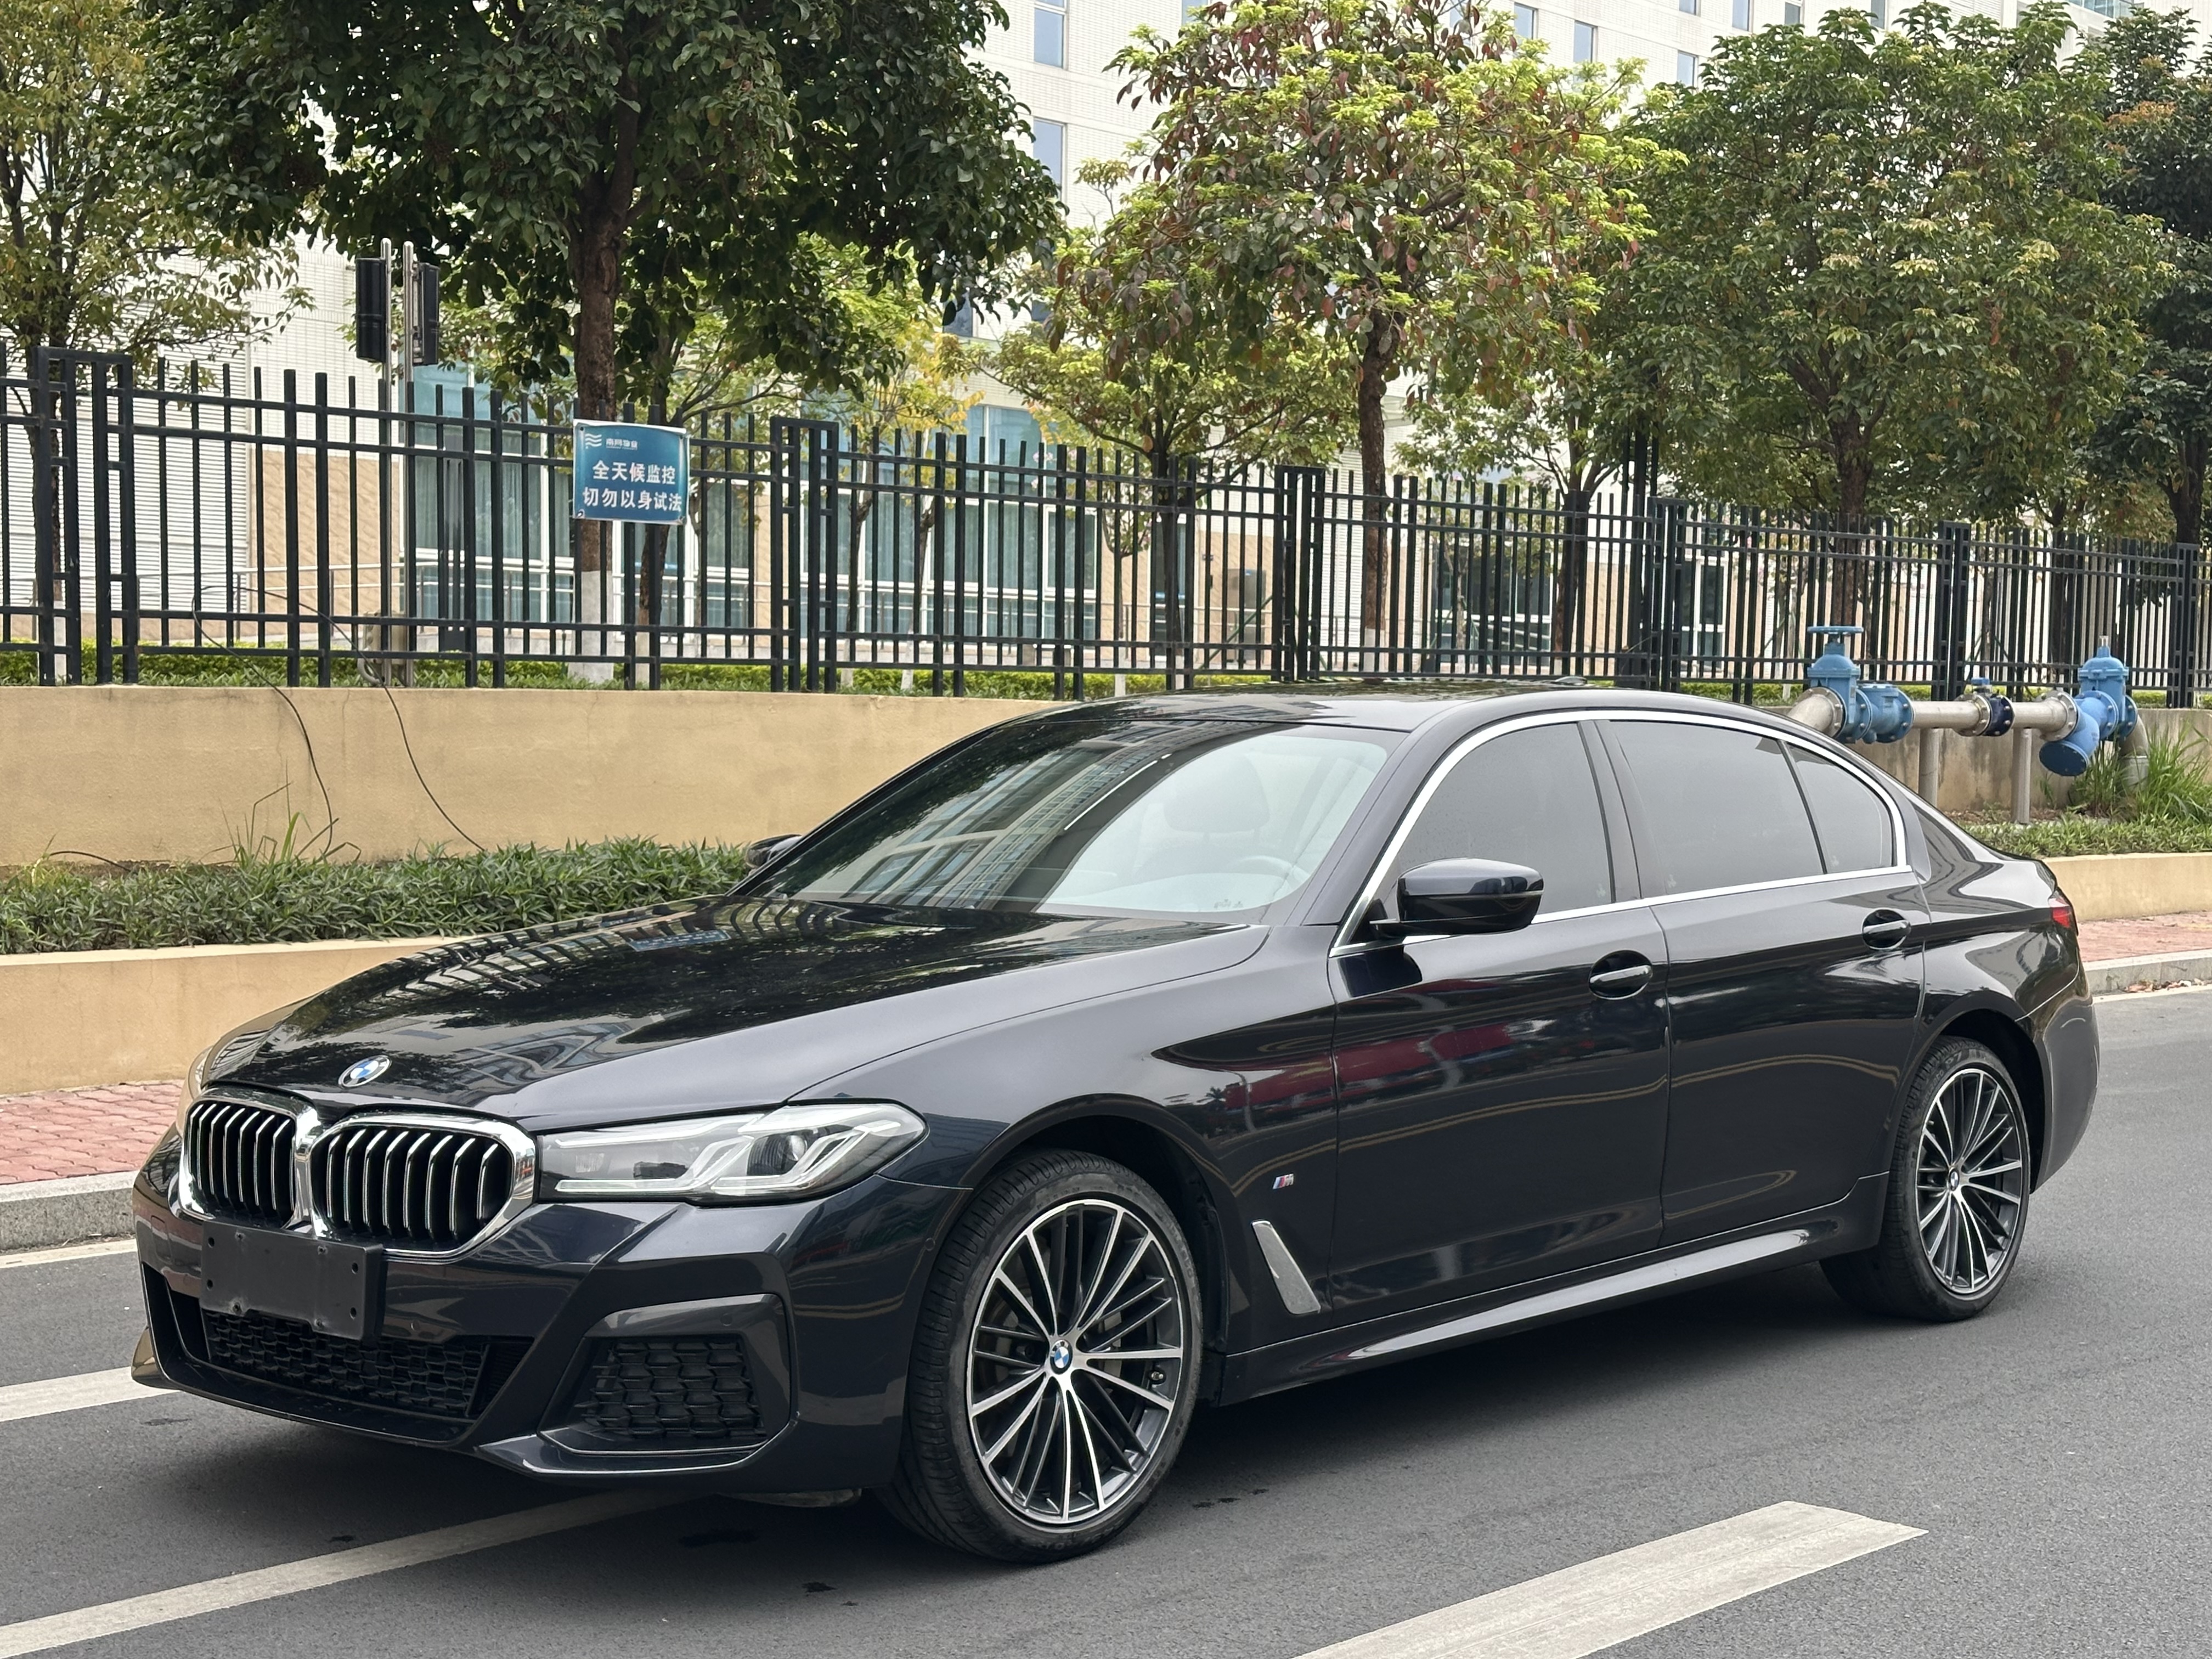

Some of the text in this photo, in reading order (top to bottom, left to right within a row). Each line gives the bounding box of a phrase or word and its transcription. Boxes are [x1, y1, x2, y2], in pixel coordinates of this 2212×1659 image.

[592, 460, 676, 485] 全天候监控
[582, 487, 682, 512] 切勿以身试法
